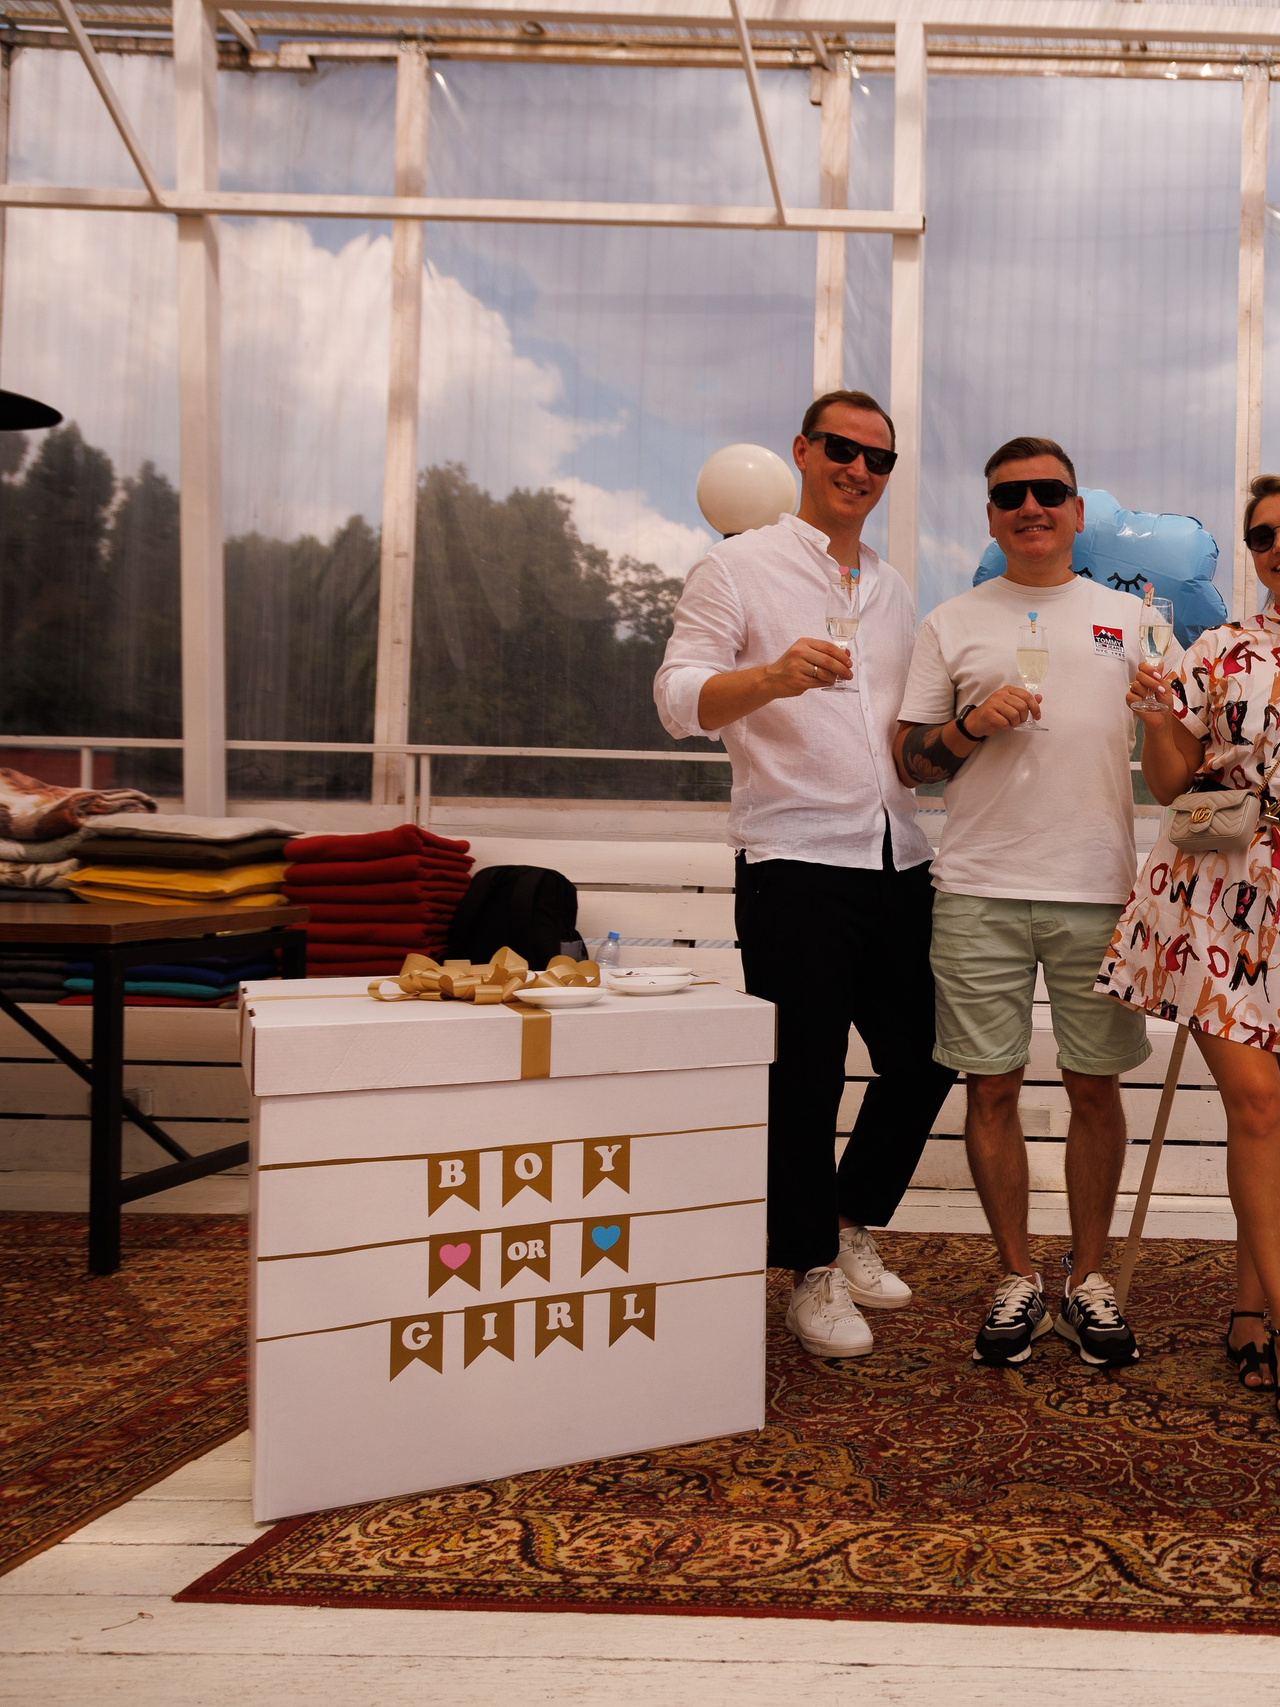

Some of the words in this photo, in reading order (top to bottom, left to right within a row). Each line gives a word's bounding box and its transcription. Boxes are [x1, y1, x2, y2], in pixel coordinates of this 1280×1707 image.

[1095, 636, 1122, 647] TOMMY
[438, 1144, 622, 1188] BOY
[507, 1239, 547, 1261] OR
[401, 1293, 645, 1350] GIRL
